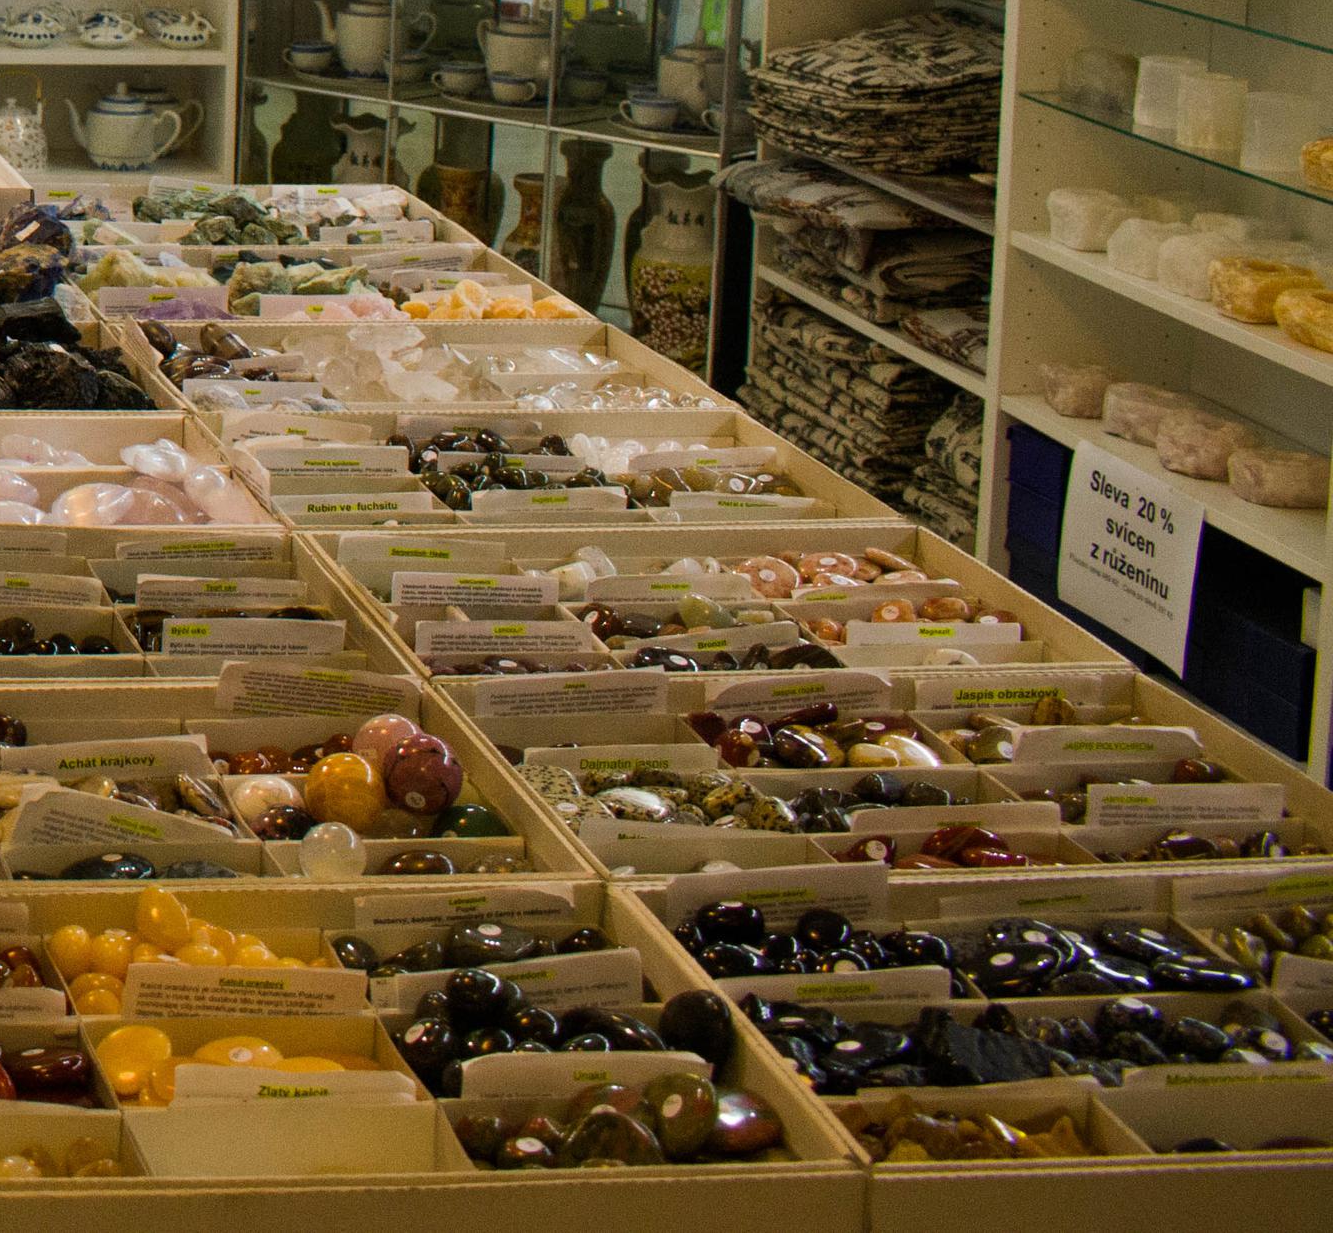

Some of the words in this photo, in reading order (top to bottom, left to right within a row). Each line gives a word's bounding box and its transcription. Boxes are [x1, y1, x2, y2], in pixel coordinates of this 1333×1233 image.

[307, 503, 336, 513] Rubin
[339, 504, 352, 512] ve
[356, 501, 398, 512] fuchsitu
[1090, 470, 1130, 509] Sleva
[1137, 496, 1156, 523] 20
[1160, 508, 1174, 534] %
[1105, 518, 1156, 558] svícen
[1090, 543, 1099, 559] z
[1102, 548, 1169, 600] růženínu
[919, 627, 950, 636] Magnezit
[698, 639, 727, 649] Bronzit
[956, 689, 995, 702] Jaspis
[997, 686, 1059, 701] obrázkový
[58, 757, 97, 769] Achát
[100, 753, 155, 769] krajkový
[580, 759, 631, 769] Dalmatin
